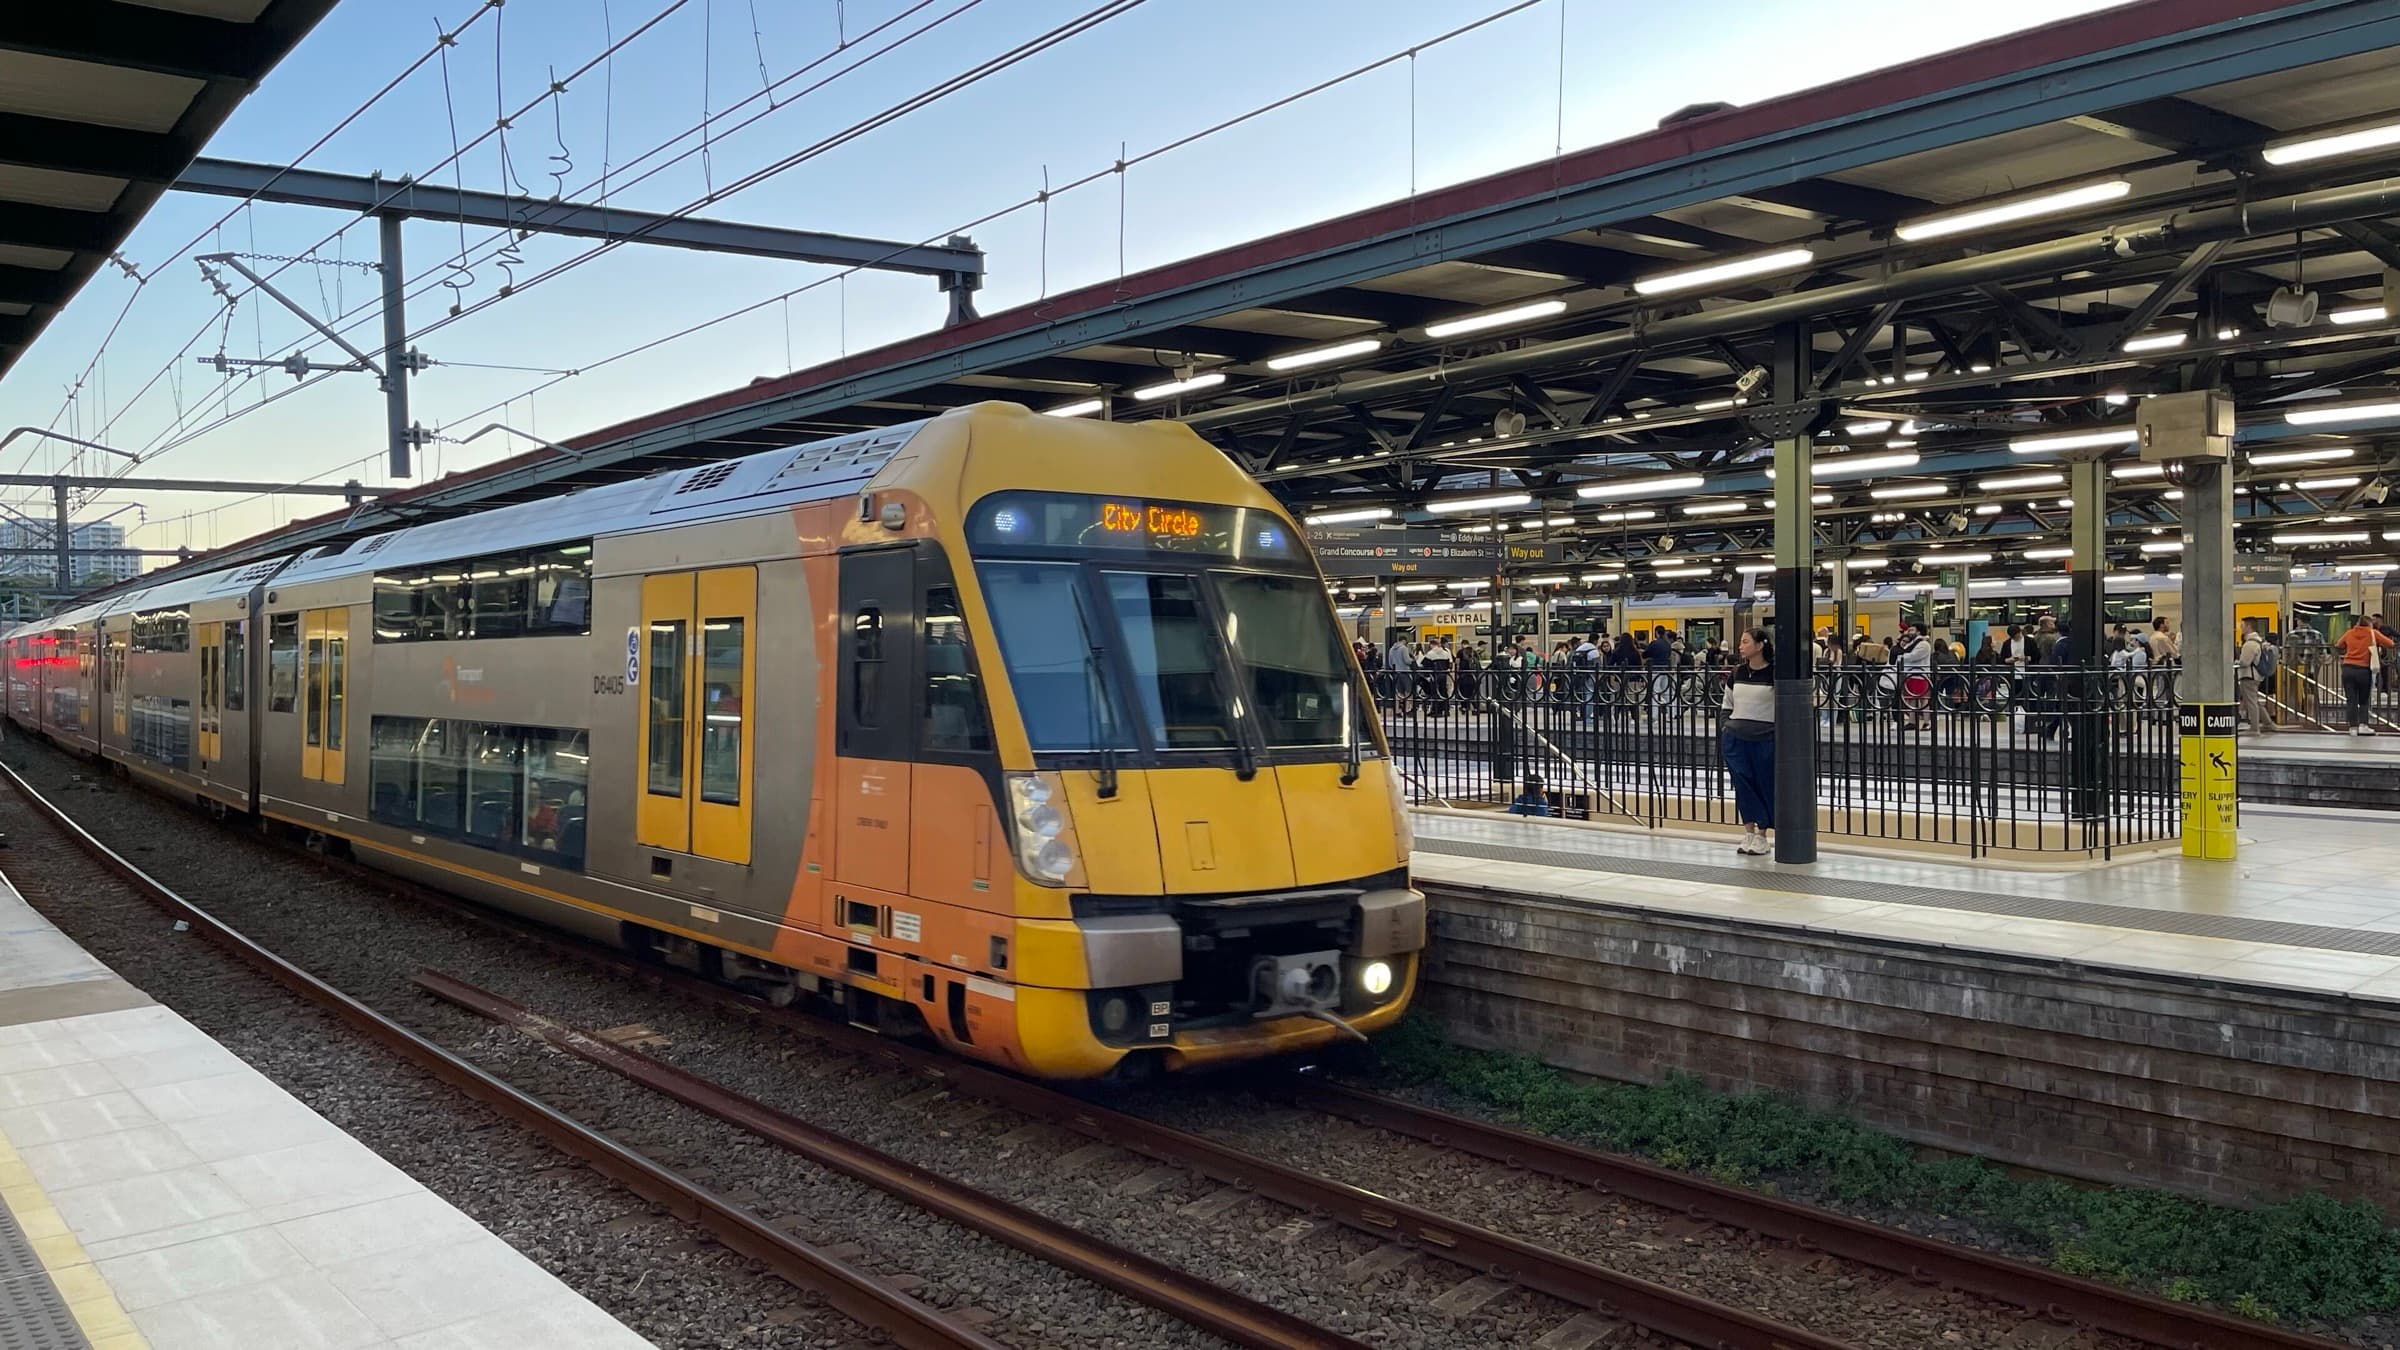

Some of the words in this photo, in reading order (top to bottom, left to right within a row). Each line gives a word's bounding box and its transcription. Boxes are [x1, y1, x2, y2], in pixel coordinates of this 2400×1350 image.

[1103, 504, 1141, 531] City
[1147, 506, 1199, 536] Circle
[1458, 535, 1473, 543] Eddy
[1319, 547, 1340, 556] Grand
[1340, 547, 1375, 556] Concourse
[1450, 548, 1477, 557] Elizabeth
[1477, 549, 1485, 557] St
[1511, 547, 1530, 560] Way
[1530, 547, 1544, 558] out
[1391, 562, 1405, 573] Way
[1406, 563, 1418, 571] out
[1436, 613, 1488, 624] CENTRAL
[594, 675, 624, 695] D6405
